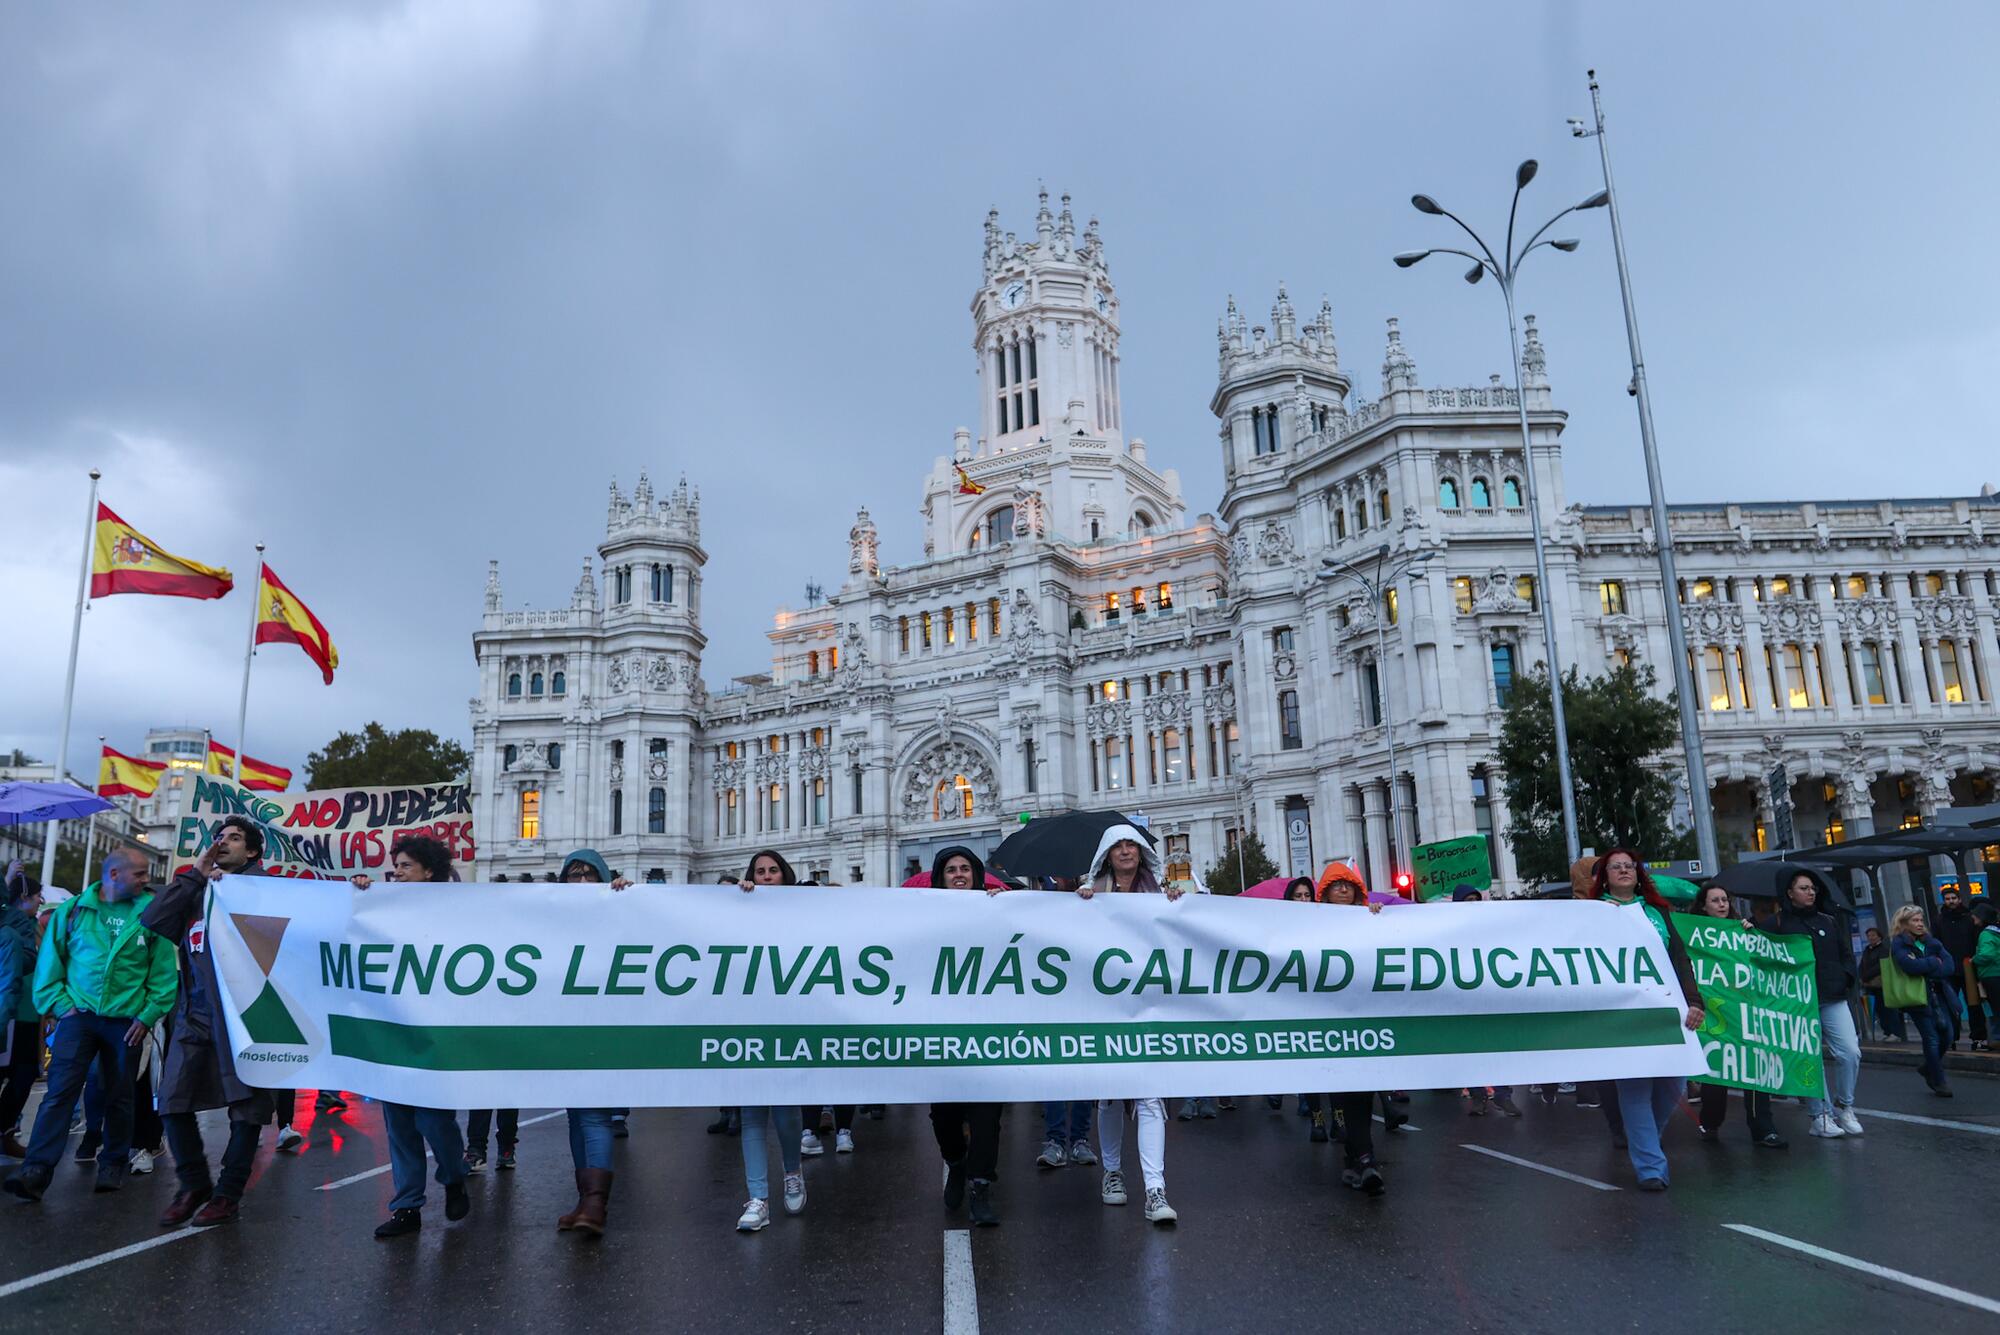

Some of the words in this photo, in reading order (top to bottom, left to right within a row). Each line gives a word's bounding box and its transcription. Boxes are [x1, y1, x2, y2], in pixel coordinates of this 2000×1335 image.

[283, 798, 341, 828] NO
[292, 832, 334, 870] CON
[340, 829, 385, 869] LAS
[1430, 867, 1478, 891] Eficacia
[319, 941, 542, 996] MENOS
[561, 944, 906, 1005] LECTIVAS,
[931, 933, 1071, 996] MÁS
[1093, 948, 1354, 996] CALIDAD
[1371, 946, 1664, 993] EDUCATIVA
[1757, 968, 1812, 1005] PALACIO
[702, 1038, 765, 1061] POR
[776, 1039, 813, 1060] LA
[822, 1029, 1050, 1060] RECUPERACIÓN
[1060, 1035, 1098, 1057] DE
[1105, 1033, 1248, 1056] NUESTROS
[1255, 1029, 1394, 1053] DERECHOS
[1740, 1003, 1820, 1056] LECTIVAS
[1702, 1040, 1784, 1090] CALIDAD
